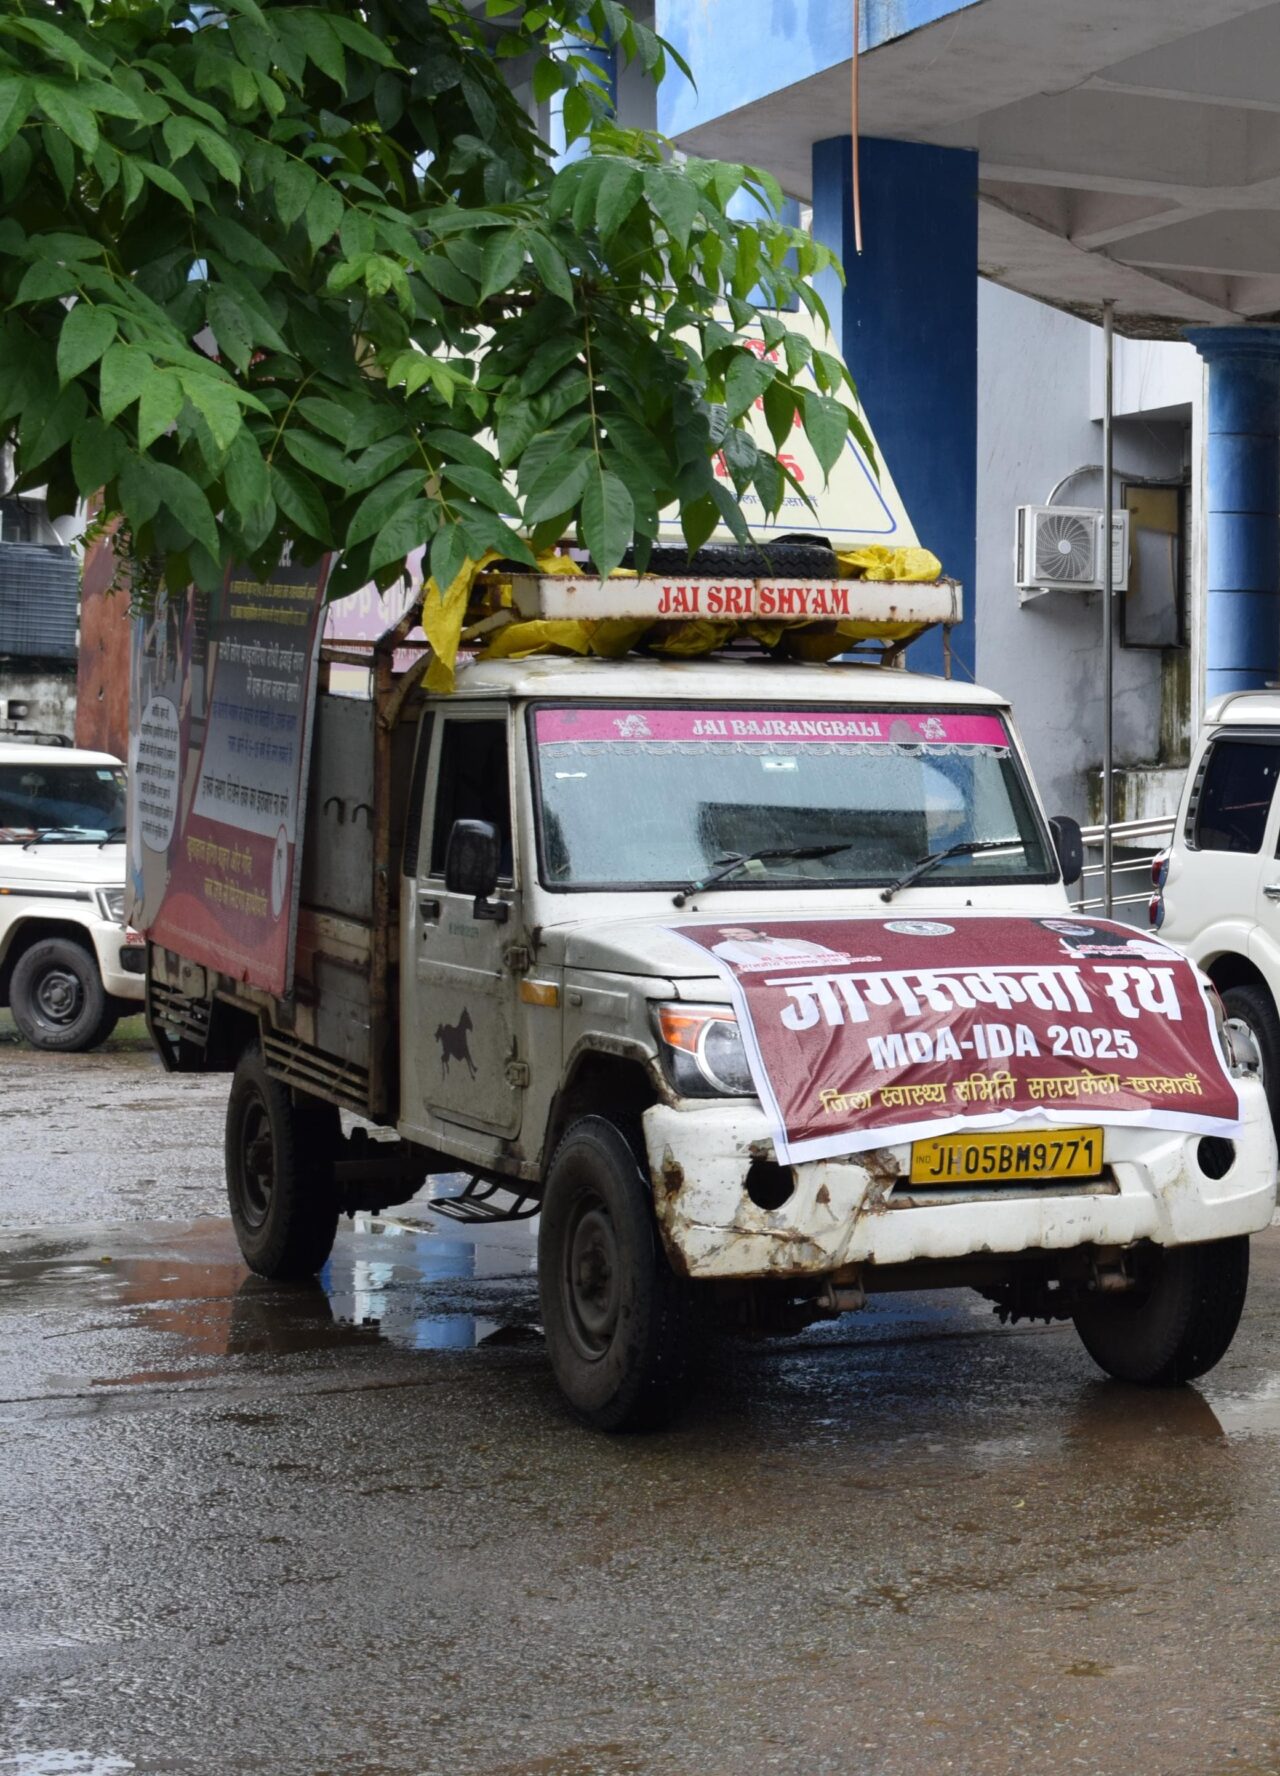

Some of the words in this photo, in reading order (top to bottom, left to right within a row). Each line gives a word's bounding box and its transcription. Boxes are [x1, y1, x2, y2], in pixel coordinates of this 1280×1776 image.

[658, 586, 700, 614] JAI
[707, 586, 753, 614] SRI
[759, 586, 850, 615] SHYAM
[692, 719, 729, 736] JAI
[729, 719, 882, 737] BAJRANGBALI
[764, 965, 1093, 1031] जागरूकता
[1093, 965, 1183, 1021] रथ
[867, 1024, 1041, 1070] MDA-IDA
[1047, 1025, 1138, 1059] 2025
[819, 1088, 873, 1115] जिला
[879, 1081, 947, 1108] स्वास्थ्य
[952, 1070, 1017, 1101] समिति
[930, 1140, 1093, 1176] JH05BM9771
